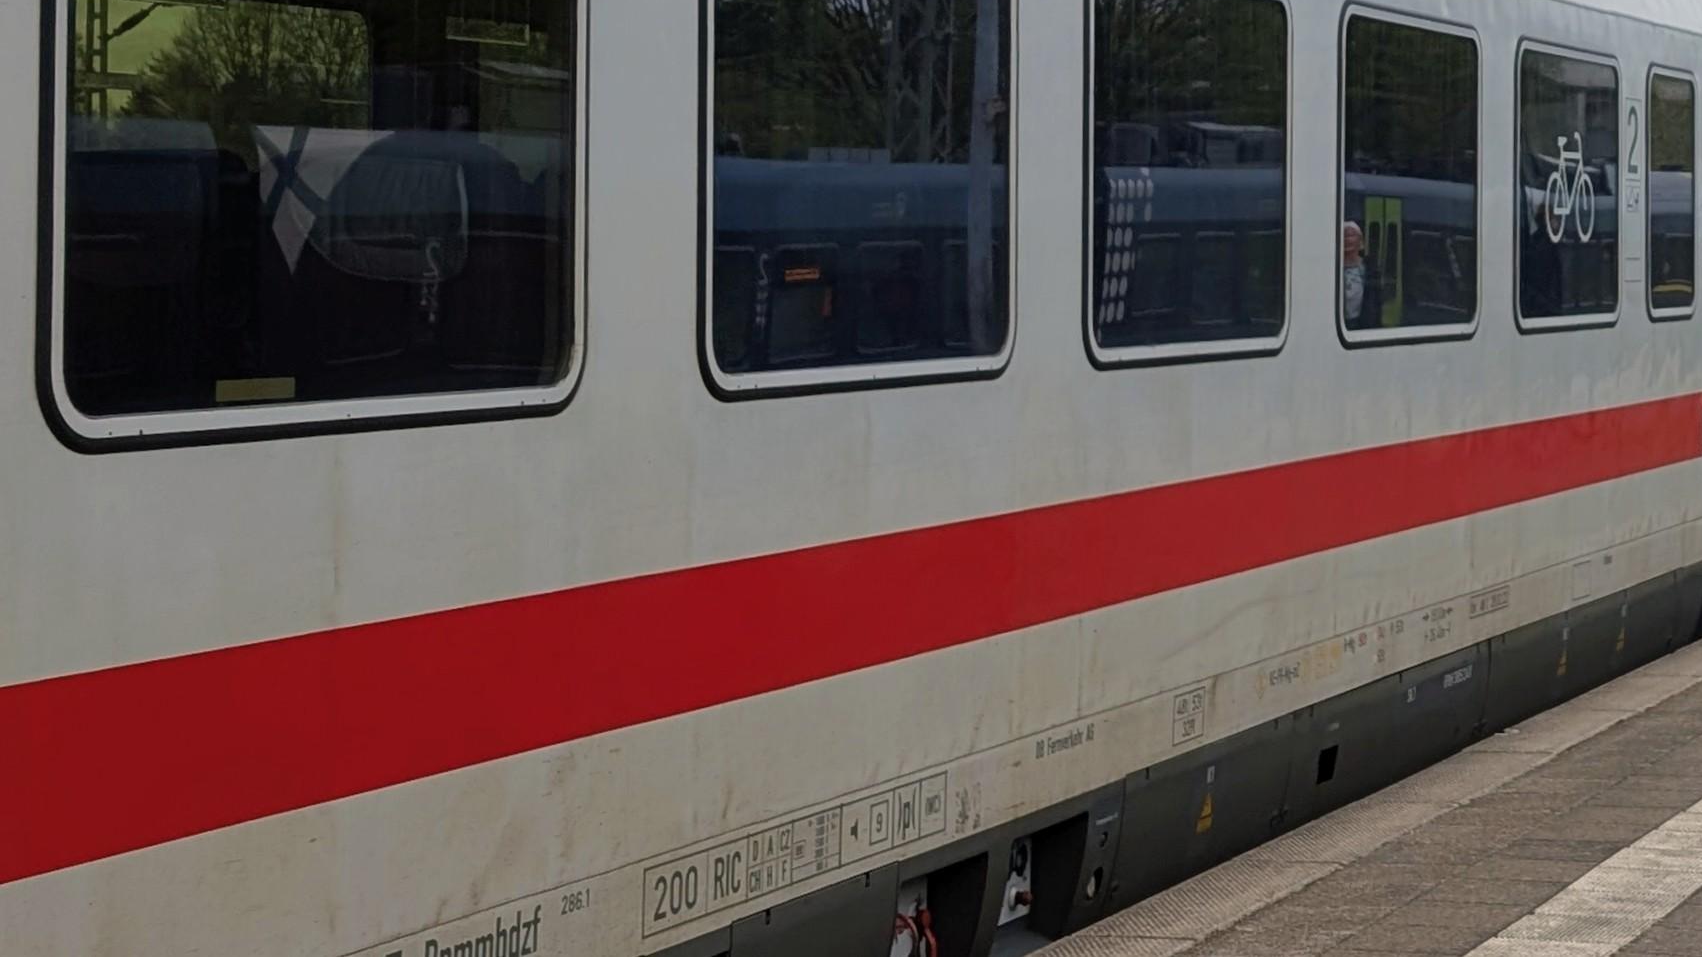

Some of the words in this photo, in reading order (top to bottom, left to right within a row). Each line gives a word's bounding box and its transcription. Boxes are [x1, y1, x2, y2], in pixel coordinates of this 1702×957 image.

[1627, 105, 1639, 175] 2
[875, 813, 883, 833] 9
[752, 840, 759, 861] D
[768, 835, 774, 856] A
[780, 829, 790, 851] CZ
[713, 851, 741, 900] RIC
[750, 868, 761, 892] CH
[766, 866, 773, 886] H
[782, 860, 787, 881] F
[561, 888, 591, 915] 286.1
[653, 866, 698, 921] 200
